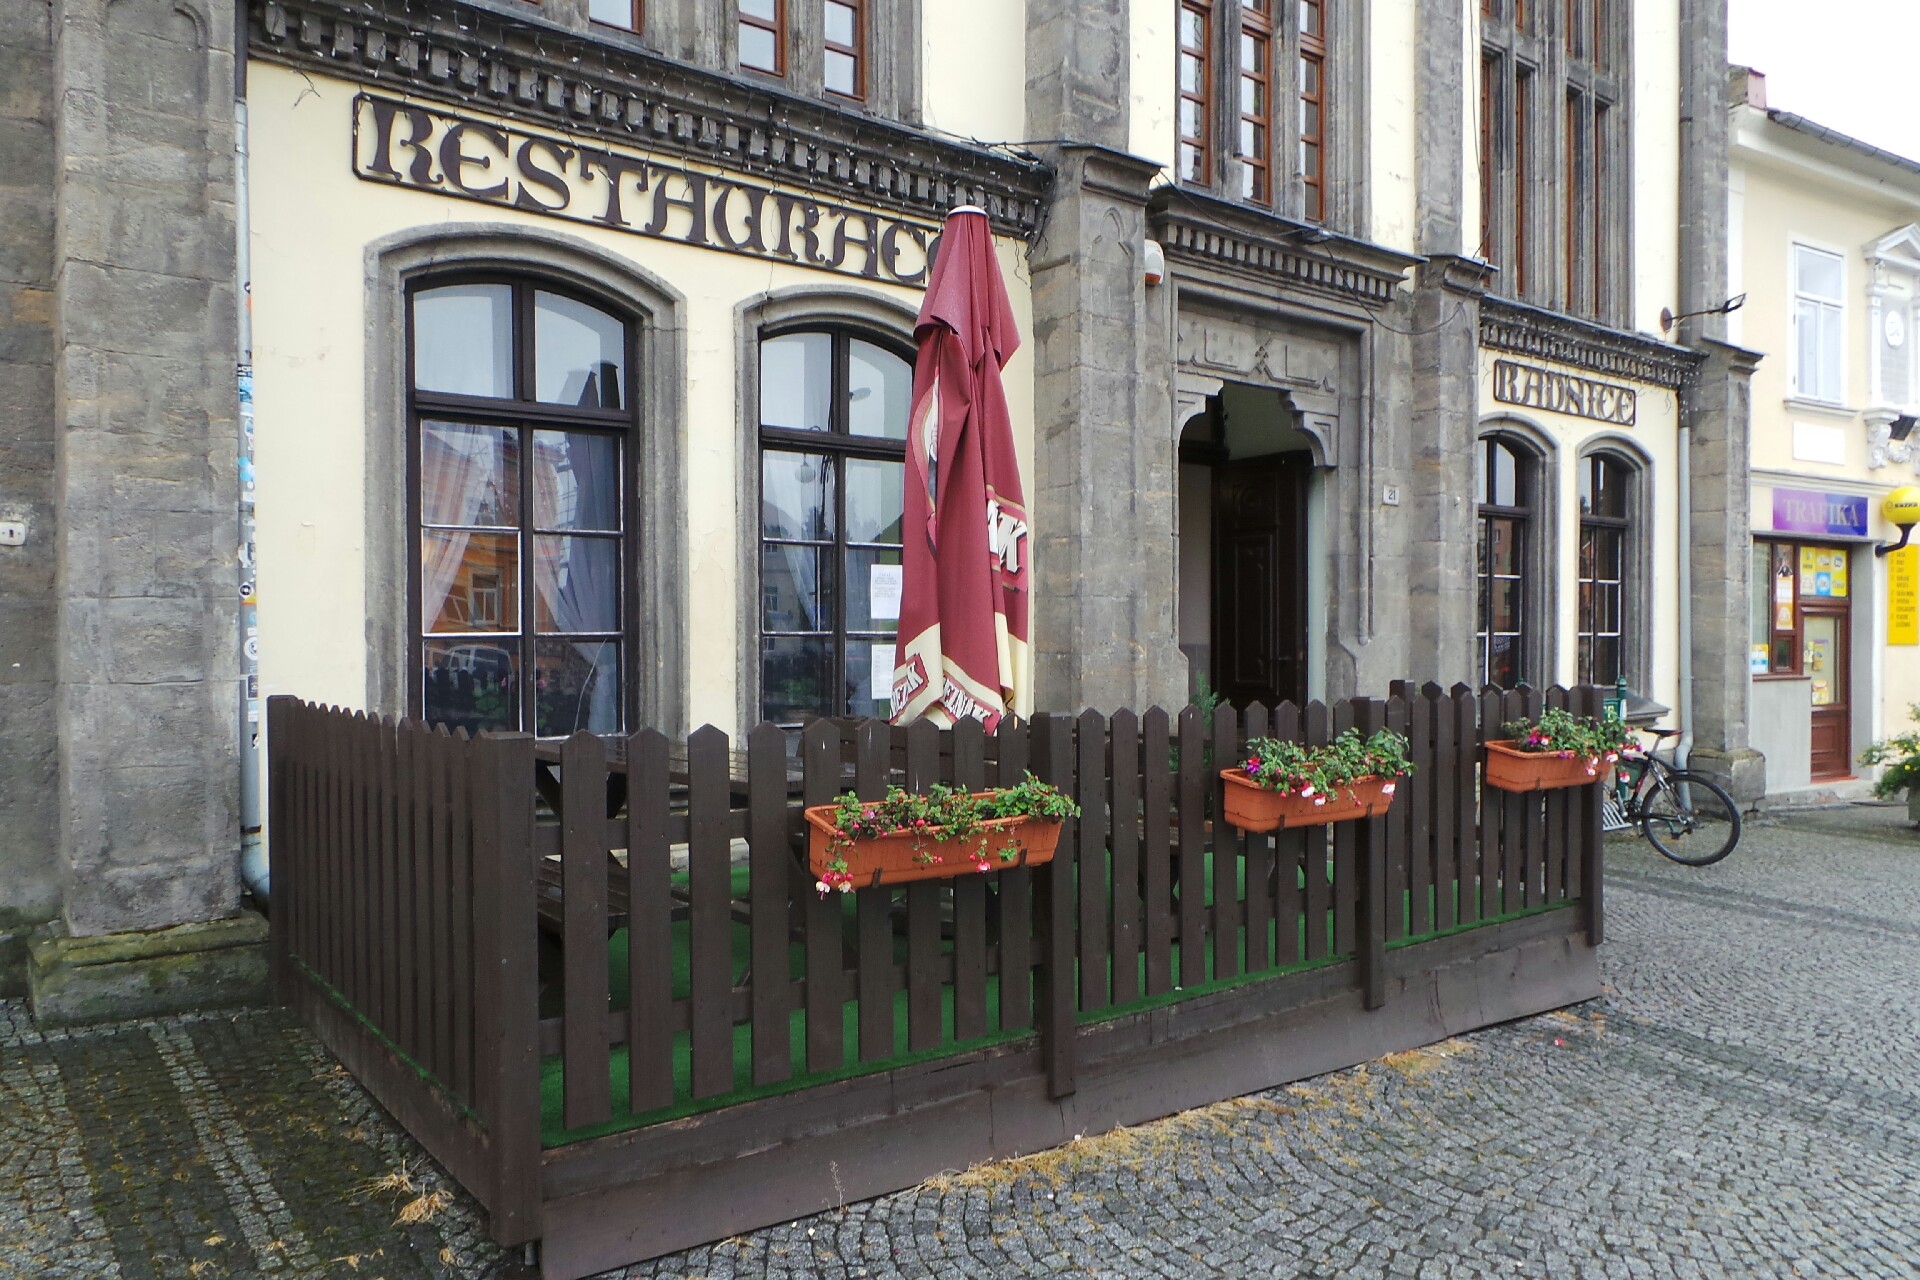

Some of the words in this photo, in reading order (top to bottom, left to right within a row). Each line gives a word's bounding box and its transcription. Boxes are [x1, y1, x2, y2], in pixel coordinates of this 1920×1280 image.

[366, 99, 942, 284] RESTAURAC
[1497, 362, 1634, 425] RADNICE
[1388, 489, 1396, 501] 21
[1783, 499, 1859, 527] TRAFIKA
